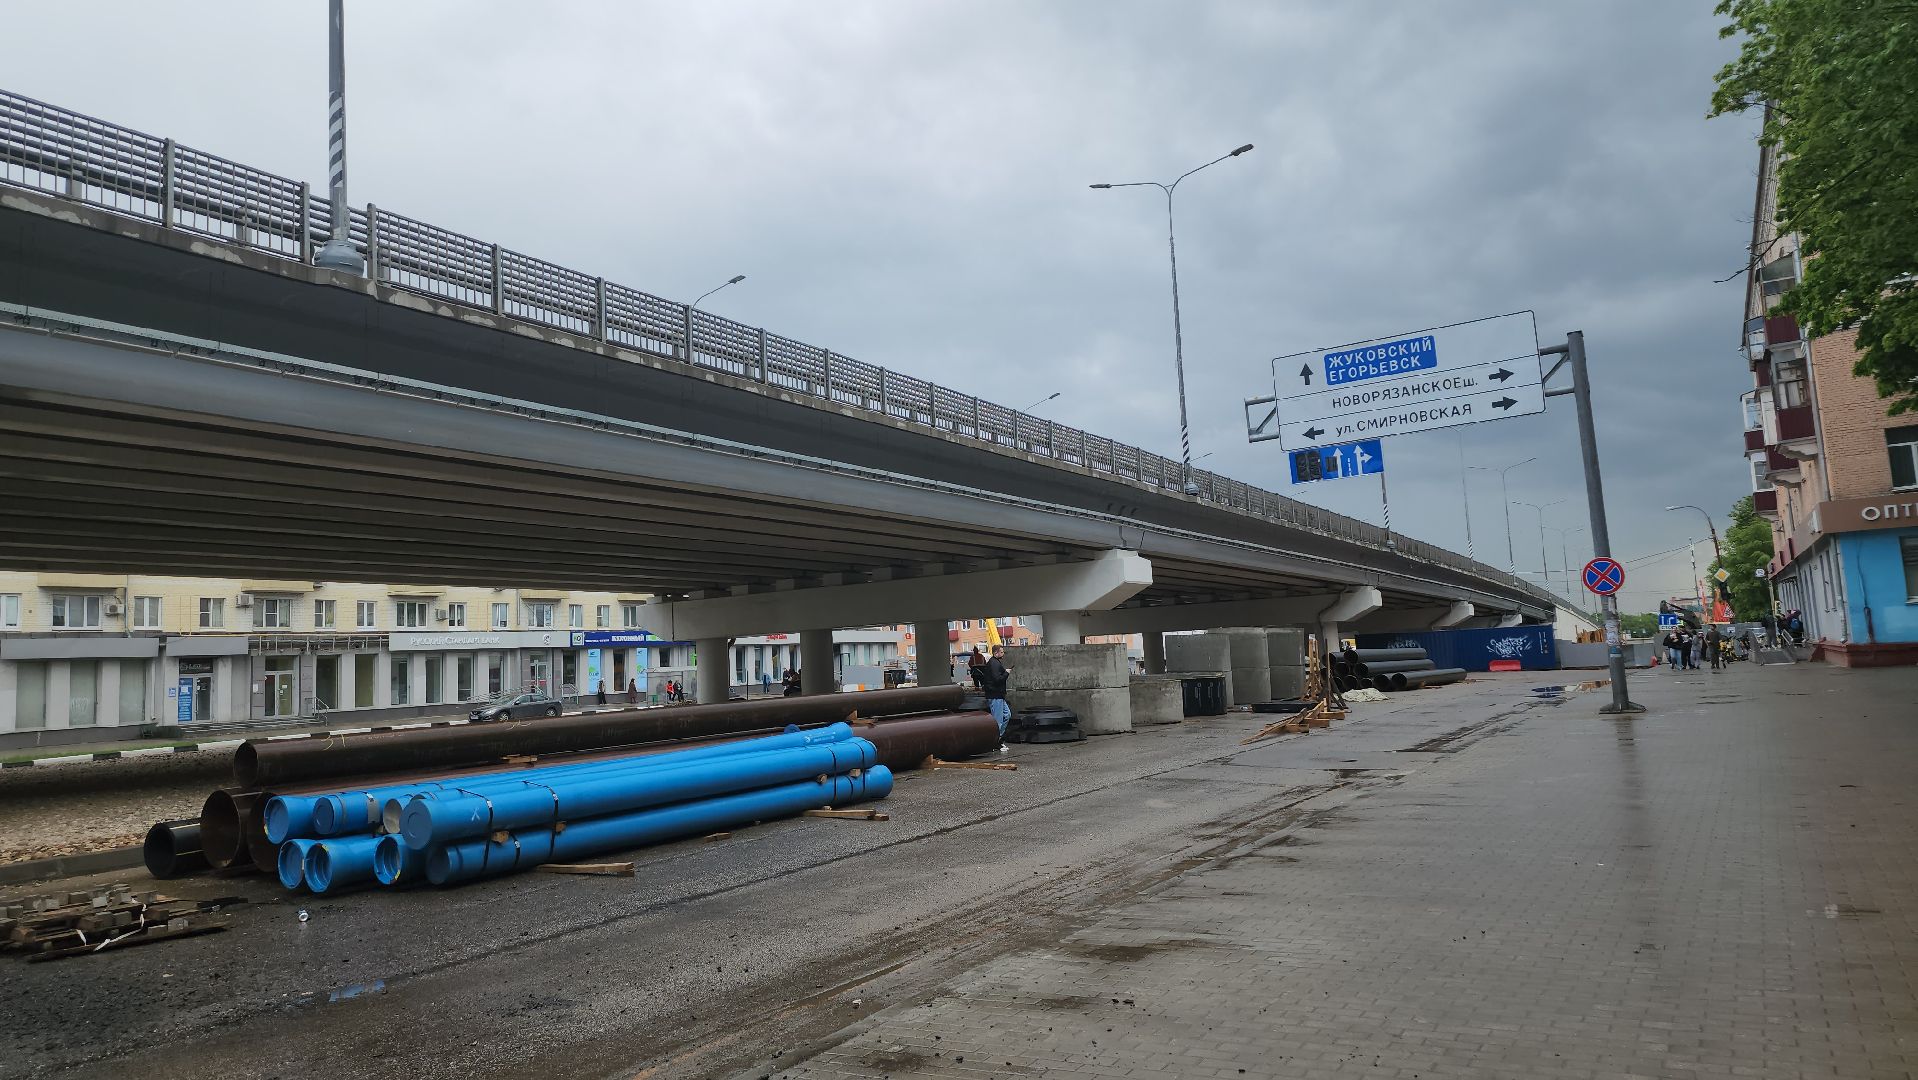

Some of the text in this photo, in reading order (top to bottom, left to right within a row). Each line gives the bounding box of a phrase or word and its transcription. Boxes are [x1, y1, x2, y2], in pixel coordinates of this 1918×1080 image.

[1329, 337, 1432, 369] ЖУКОВСКИЙ
[1329, 355, 1421, 382] ЕГОРЬЕВСК
[1861, 502, 1918, 521] ОПТ
